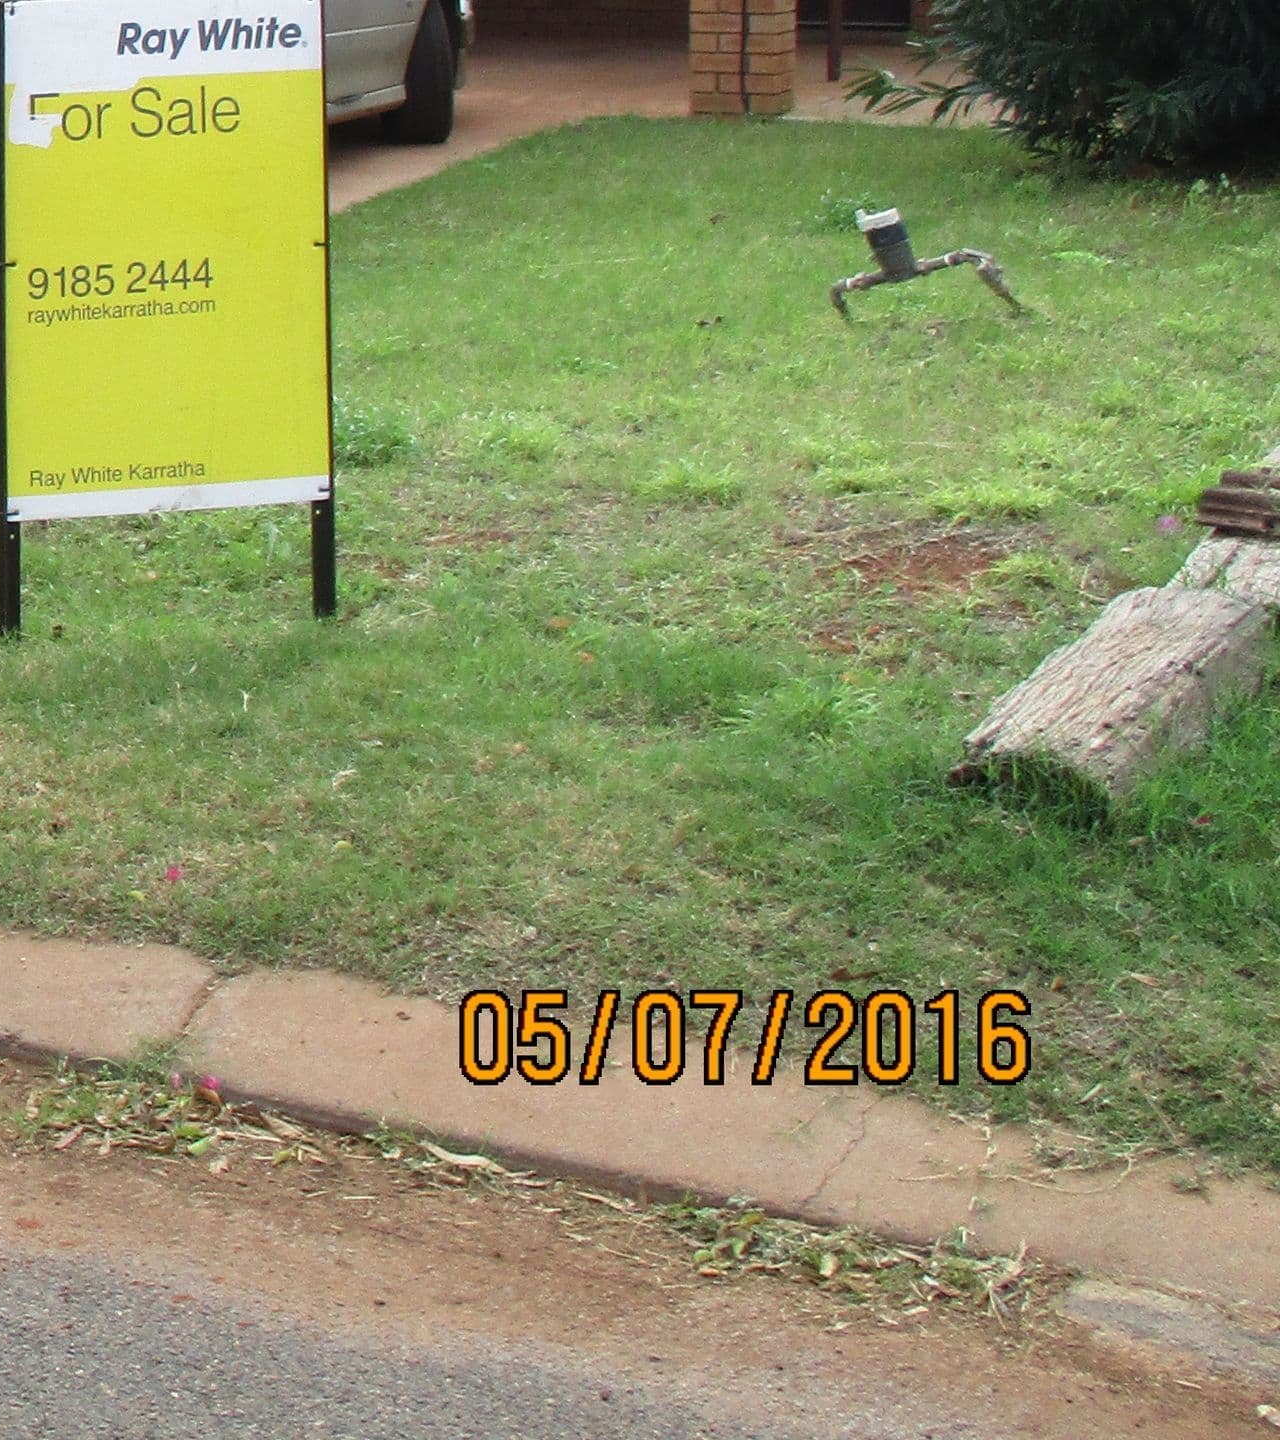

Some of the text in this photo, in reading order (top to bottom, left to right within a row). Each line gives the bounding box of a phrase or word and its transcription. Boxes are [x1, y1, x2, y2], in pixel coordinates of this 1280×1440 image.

[116, 16, 303, 60] Ray White
[130, 86, 241, 138] Sale
[28, 257, 214, 300] 9185 2444
[28, 298, 216, 327] raywhitekarratha.com
[29, 461, 206, 490] Ray White Karratha
